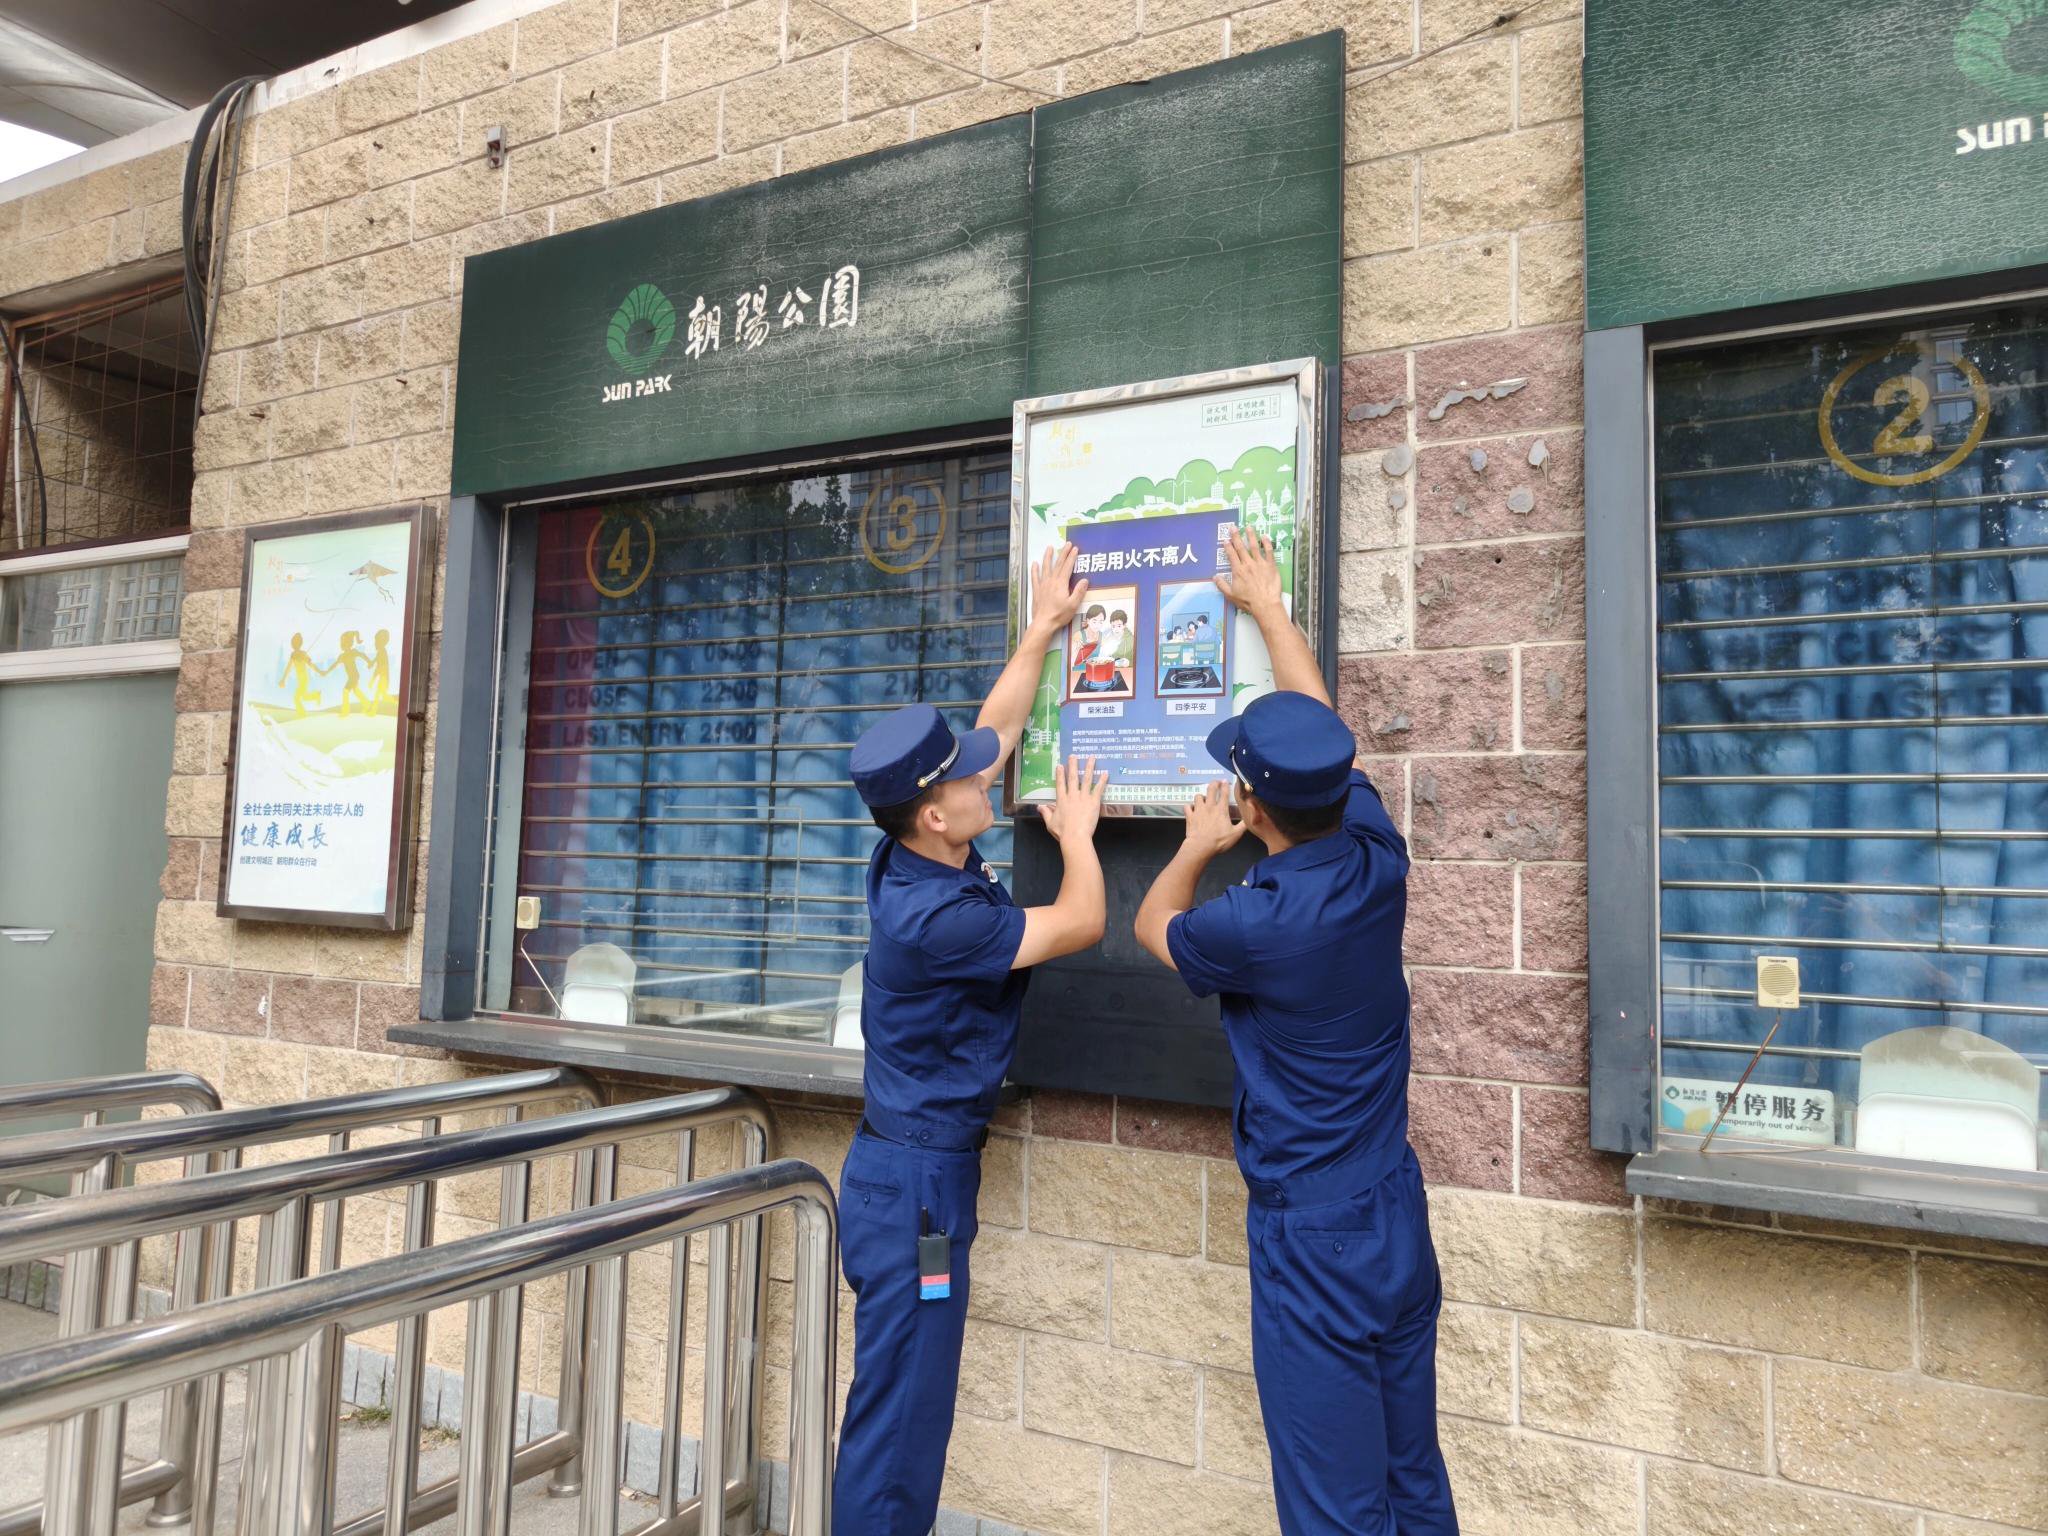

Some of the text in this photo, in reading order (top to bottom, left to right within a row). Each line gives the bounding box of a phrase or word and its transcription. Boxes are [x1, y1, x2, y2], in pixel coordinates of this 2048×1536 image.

[1956, 116, 2031, 155] SUN
[602, 374, 672, 404] SUN PARK
[1873, 375, 1935, 454] 2
[888, 496, 917, 551] 3
[607, 527, 632, 576] 4
[1073, 543, 1199, 574] 厨房用火不离人
[564, 685, 628, 710] CLOSE
[884, 670, 951, 697] 2100
[1087, 705, 1116, 715] 柴米油盐
[1175, 702, 1207, 712] 四季平安
[562, 725, 609, 747] LAST
[616, 722, 687, 746] ENTRY
[242, 803, 364, 817] 全社会共同关注未成年人的
[1716, 1091, 1825, 1121] 暂停服务
[1720, 1118, 1766, 1129] emporarily
[1768, 1122, 1783, 1130] out
[1784, 1122, 1795, 1130] of
